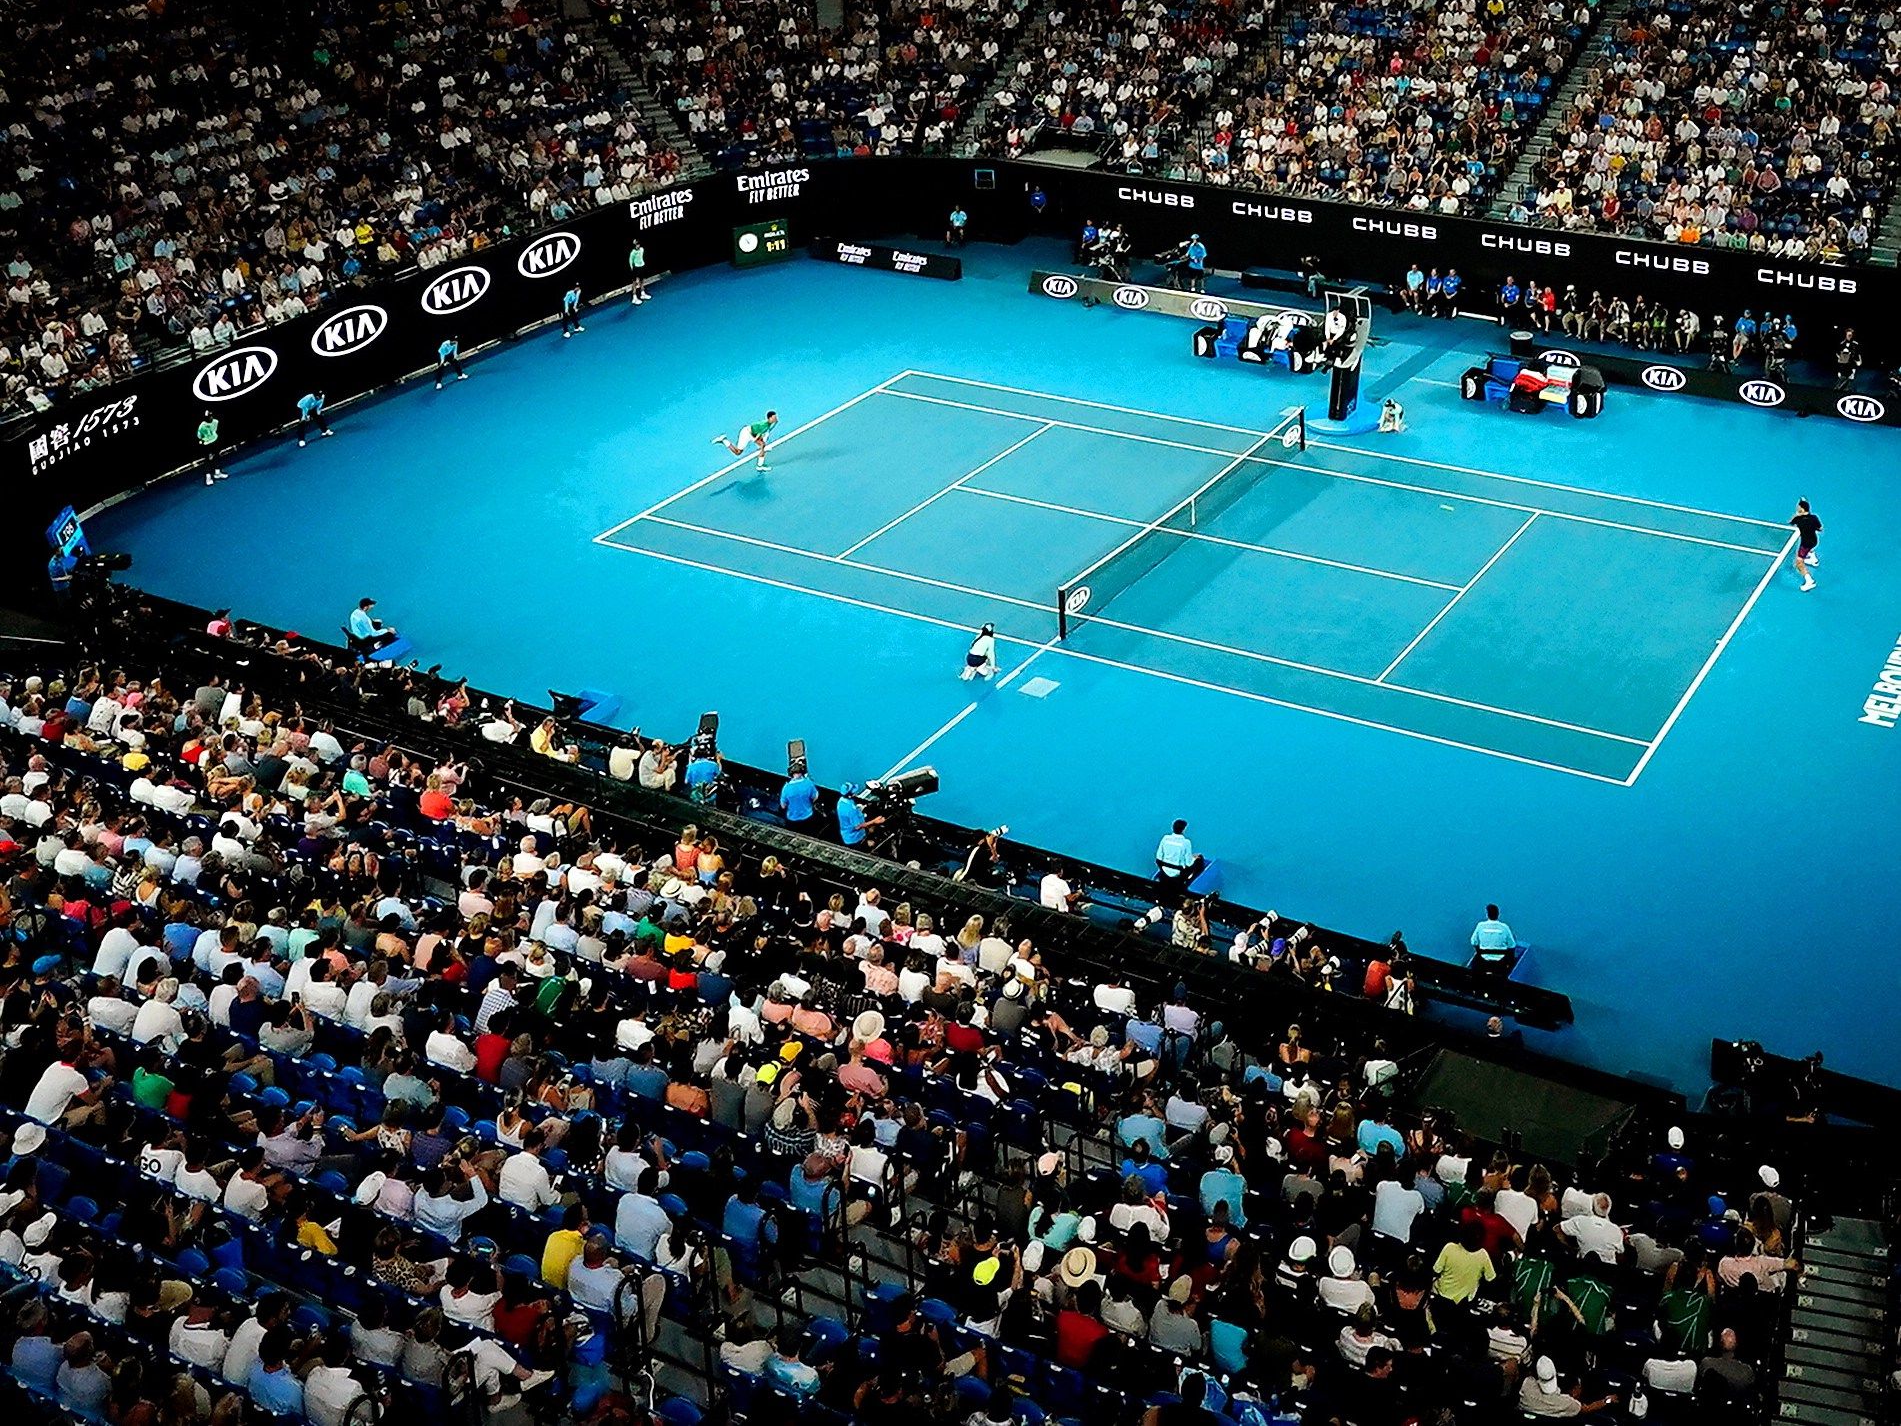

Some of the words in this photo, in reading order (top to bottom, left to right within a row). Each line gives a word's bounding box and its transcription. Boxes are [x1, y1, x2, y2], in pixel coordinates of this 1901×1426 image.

[737, 168, 810, 192] Emirates
[629, 188, 694, 218] Emirates
[766, 184, 800, 201] BETTER
[1118, 187, 1195, 208] CHUBB
[653, 205, 684, 226] BETTER
[1232, 201, 1313, 224] CHUBB
[1352, 217, 1437, 240] CHUBB
[528, 239, 572, 273] KIA
[1481, 233, 1571, 257] CHUBB
[1615, 250, 1710, 275] CHUBB
[432, 272, 481, 310] KIA
[1049, 279, 1072, 294] KIA
[1757, 268, 1857, 294] CHUBB
[1118, 289, 1144, 307] KIA
[323, 312, 376, 353] KIA
[207, 350, 263, 397] KIA
[1651, 371, 1680, 386] KIA
[1747, 385, 1777, 402] KIA
[73, 394, 138, 439] 1573
[1845, 399, 1876, 417] KIA
[102, 416, 140, 438] 1573
